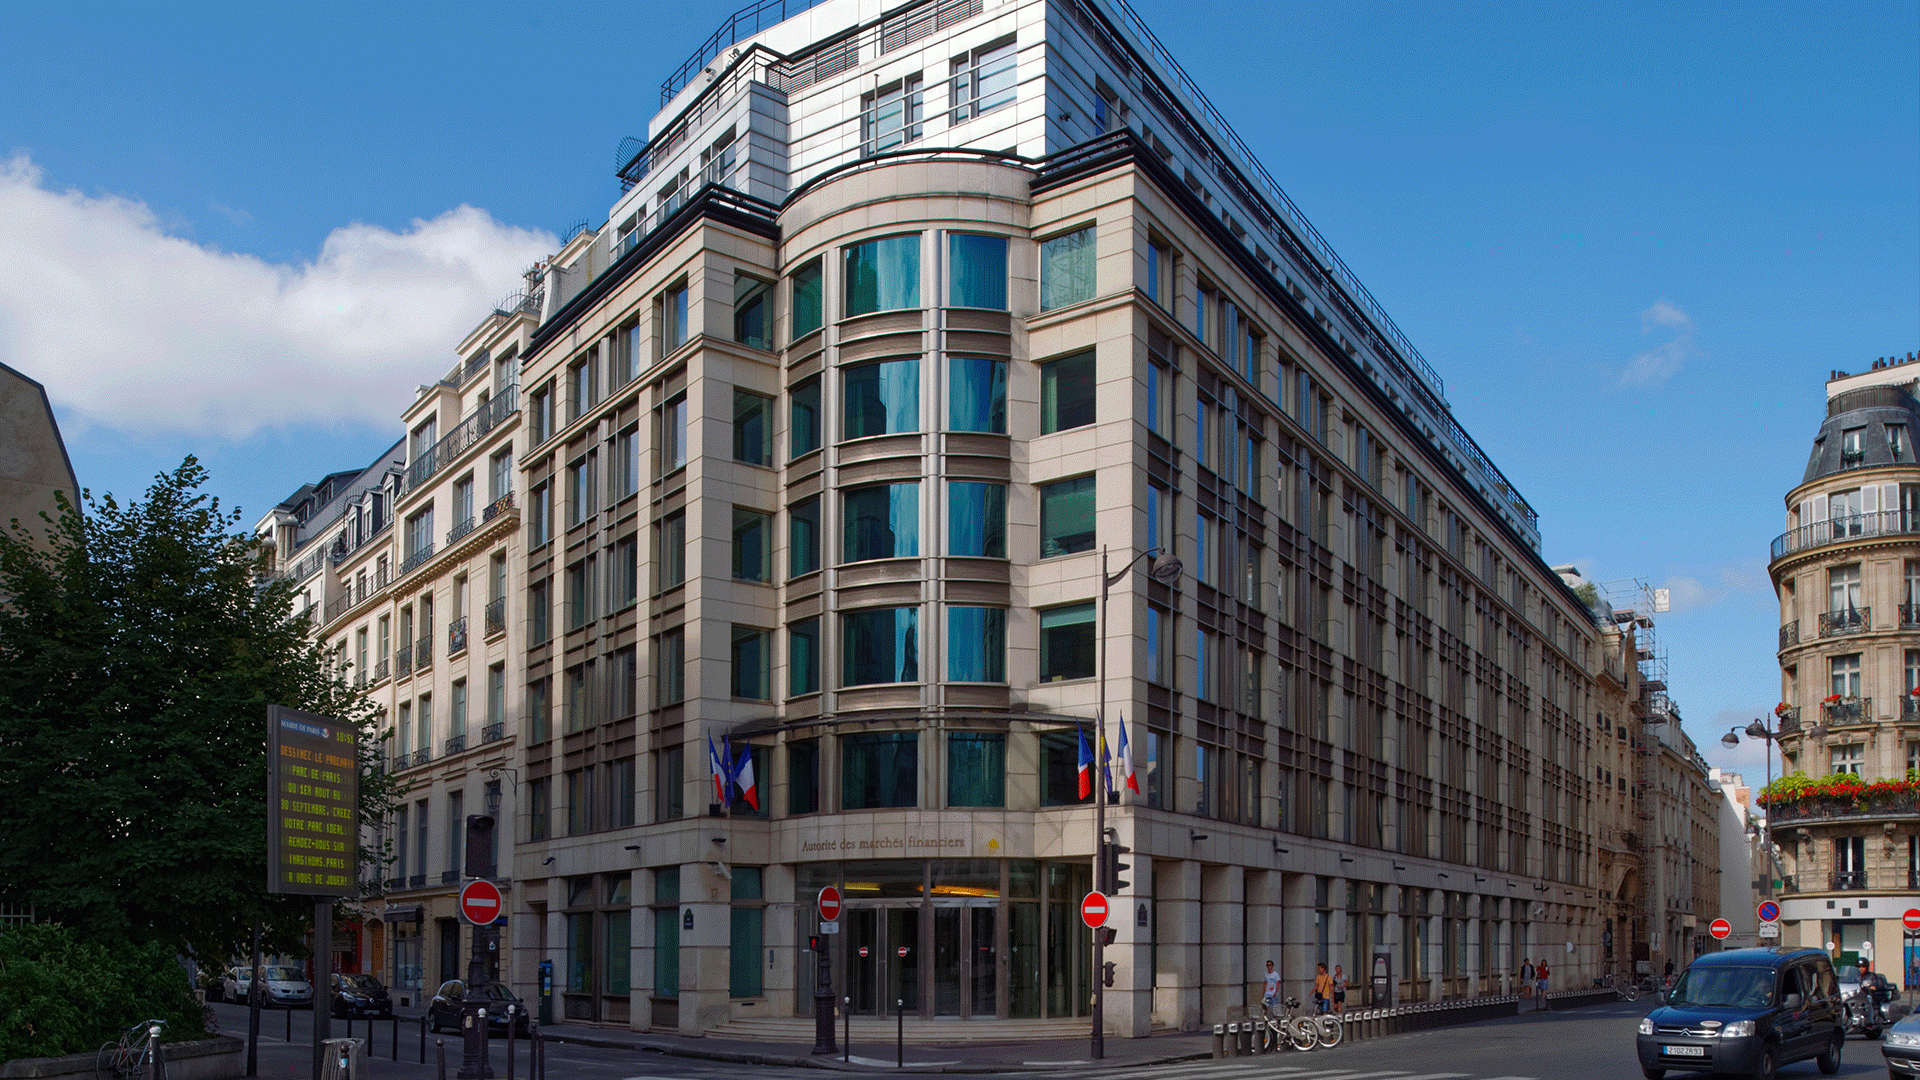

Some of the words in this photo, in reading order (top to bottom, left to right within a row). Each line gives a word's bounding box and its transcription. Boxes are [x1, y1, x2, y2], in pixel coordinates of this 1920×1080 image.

[299, 723, 306, 732] DE
[306, 725, 320, 736] PARIS
[336, 731, 354, 745] 10:51
[281, 744, 312, 761] DESSINEZ
[315, 752, 322, 763] LE
[292, 765, 308, 778] PARC
[311, 768, 319, 780] DE
[322, 771, 341, 784] PARIS
[281, 799, 289, 810] 30
[333, 806, 351, 819] CREEZ
[284, 817, 304, 830] VOTRE
[307, 820, 322, 833] PARC
[333, 841, 345, 852] SUR
[802, 839, 837, 852] Autorité
[839, 838, 856, 850] des
[859, 836, 904, 849] marchés
[907, 835, 965, 848] financiers
[288, 872, 293, 883] A
[296, 872, 312, 884] VOUS
[315, 873, 323, 885] DE
